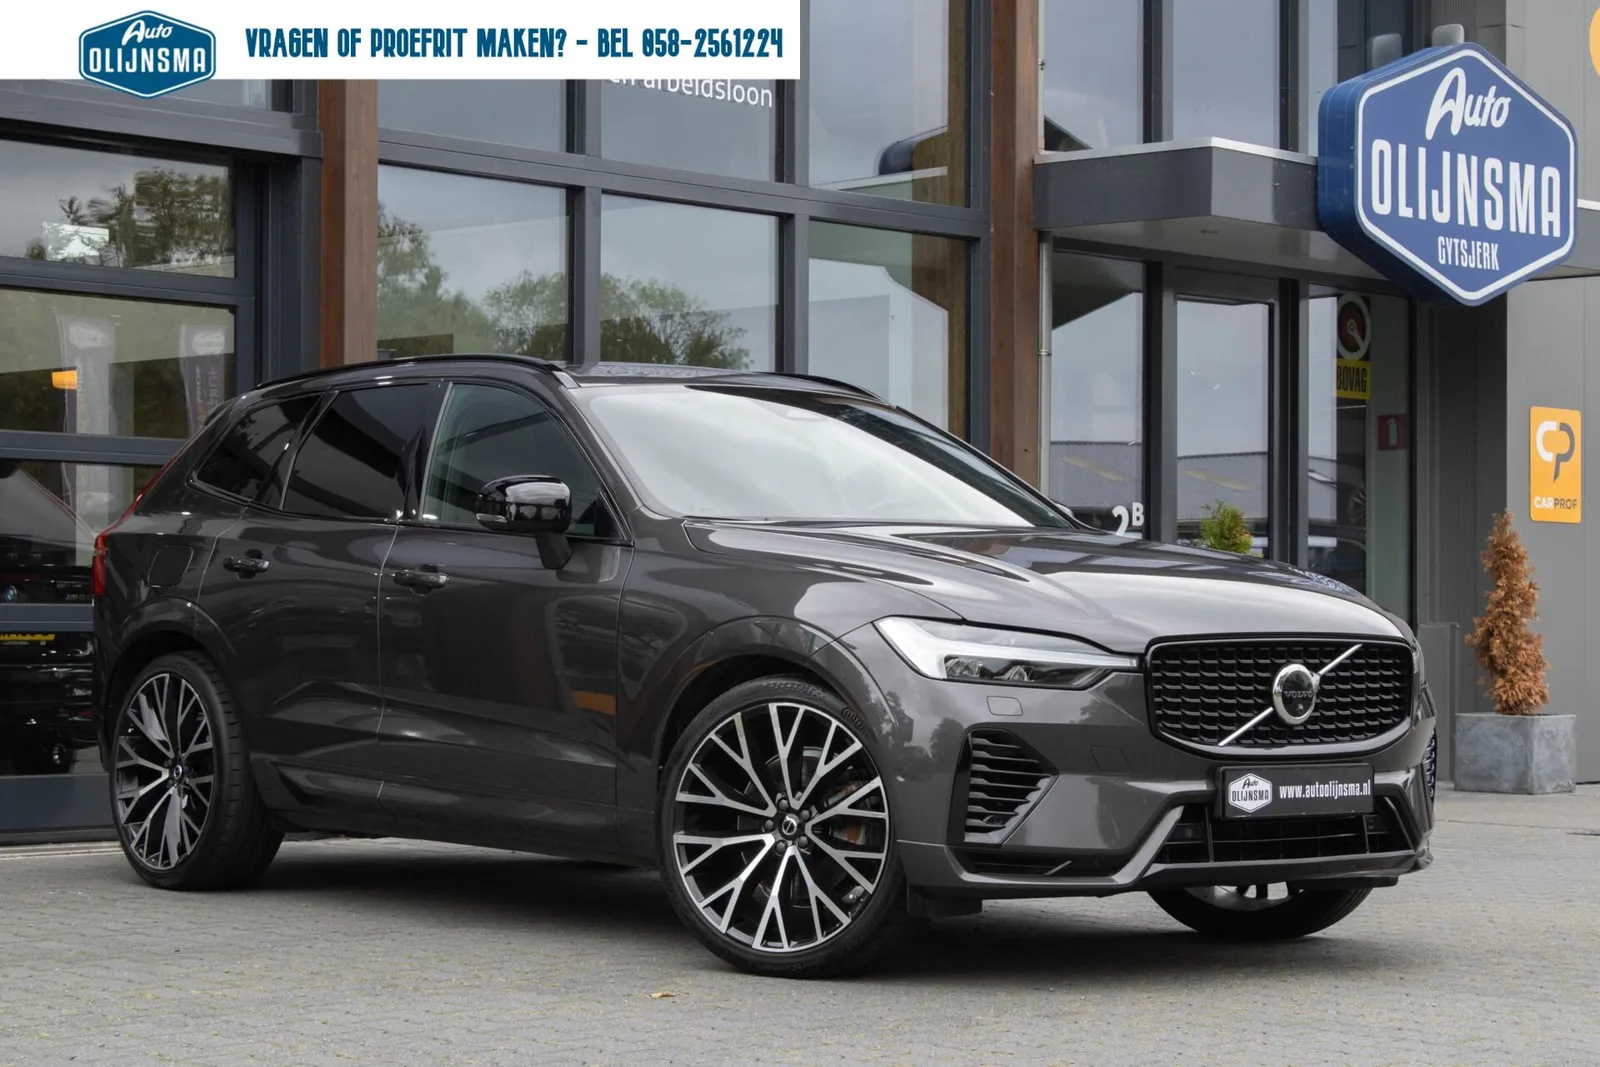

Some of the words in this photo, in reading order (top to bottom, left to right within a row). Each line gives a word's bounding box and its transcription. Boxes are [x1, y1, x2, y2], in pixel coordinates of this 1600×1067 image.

[1425, 66, 1511, 141] Auto
[1371, 138, 1561, 238] OLIJNSMA
[1438, 236, 1500, 271] GYTSJERK
[1336, 364, 1368, 394] BOVAG
[1534, 496, 1578, 510] CARPROF
[1283, 690, 1314, 699] VOLVO
[1242, 777, 1259, 790] Auto
[1279, 779, 1371, 800] www.autoolijnsma.nl
[1232, 790, 1269, 802] OLIJNSMA
